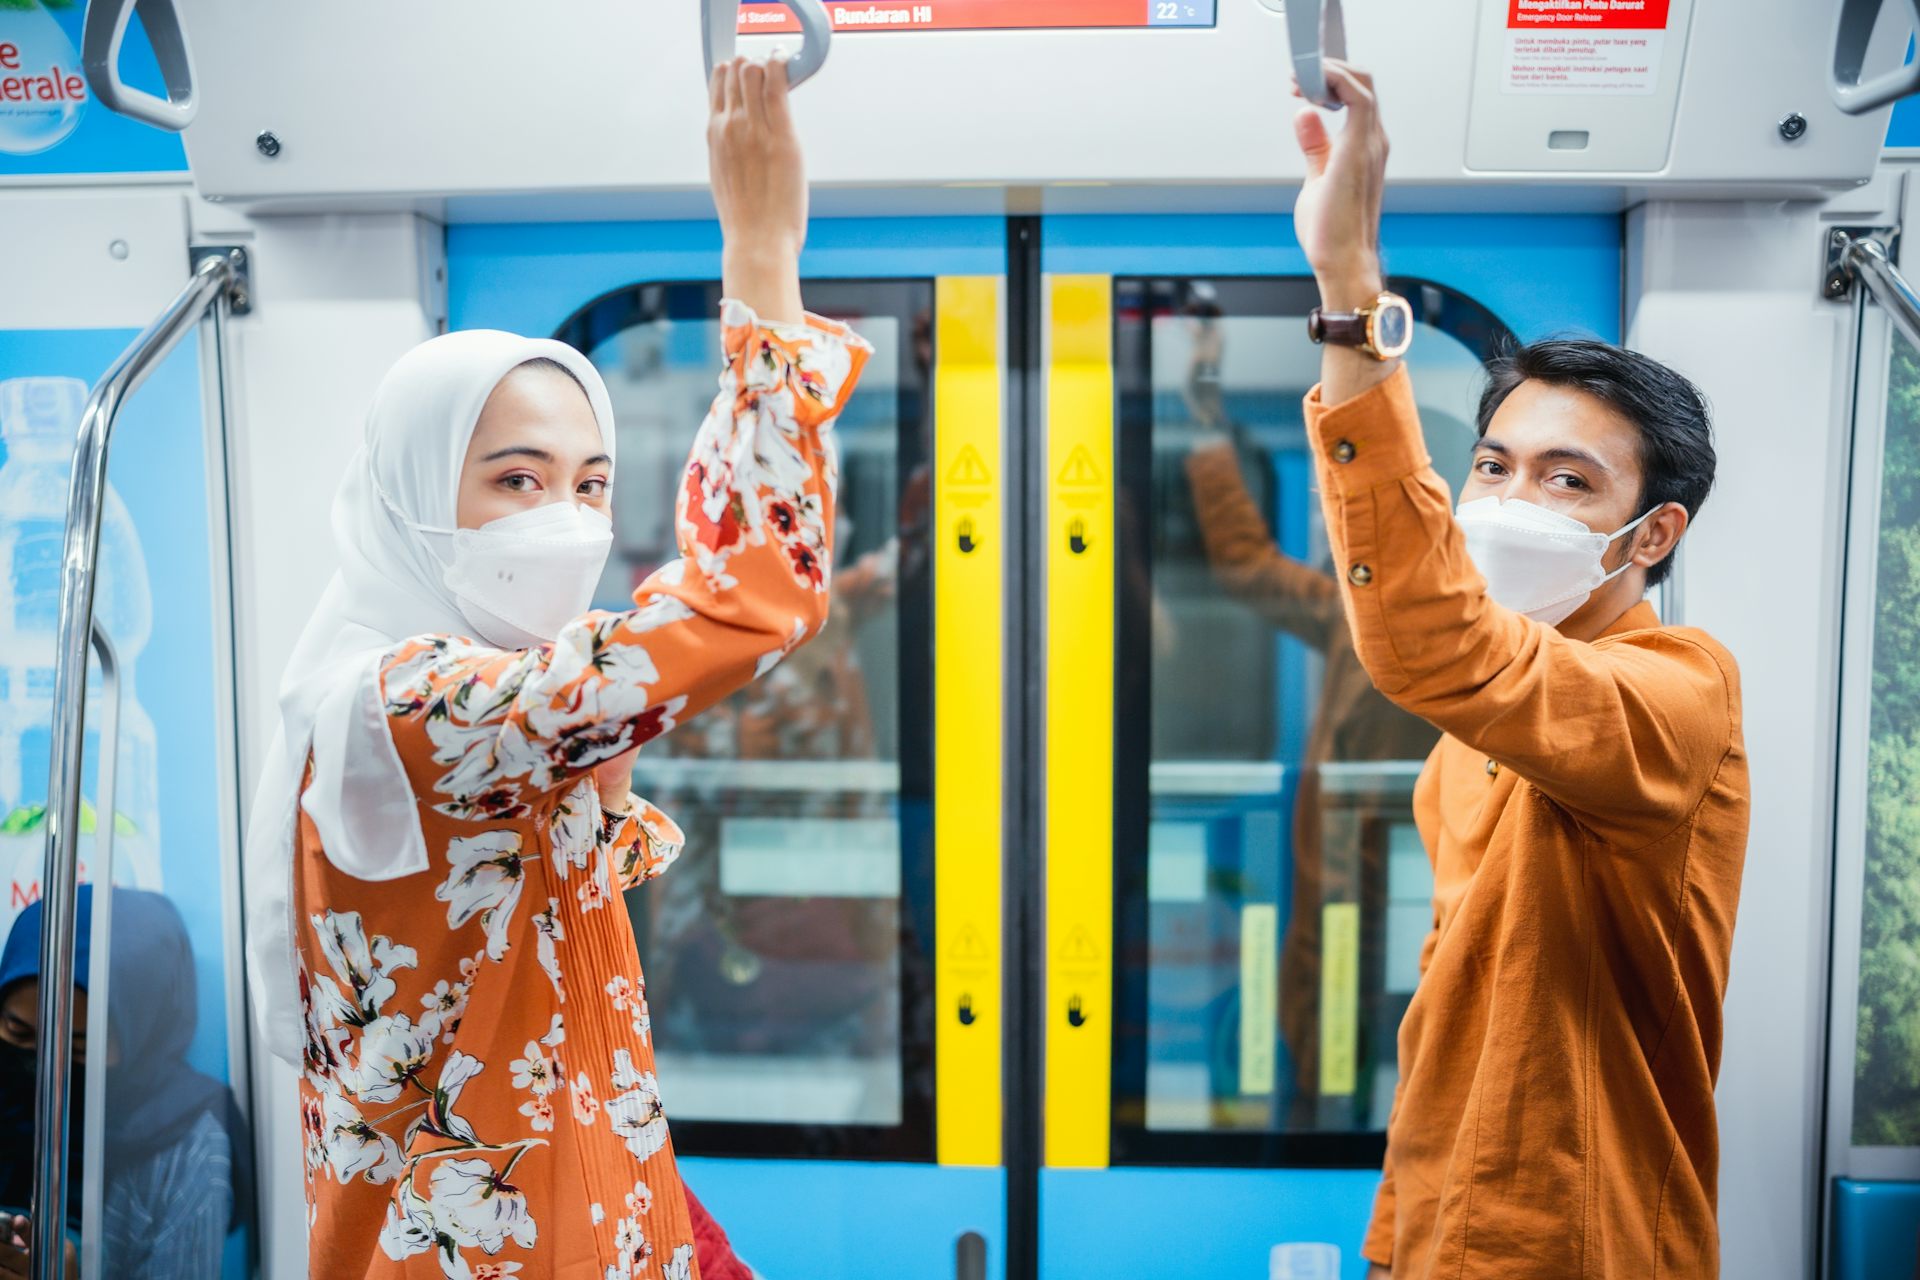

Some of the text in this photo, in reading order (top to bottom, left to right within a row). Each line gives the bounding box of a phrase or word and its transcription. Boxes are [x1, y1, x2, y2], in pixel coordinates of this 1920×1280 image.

[747, 12, 786, 23] Station
[834, 6, 932, 24] Bundaran HI
[1157, 3, 1178, 19] 22
[1517, 13, 1603, 23] Emergency Door Release
[0, 65, 86, 101] erale
